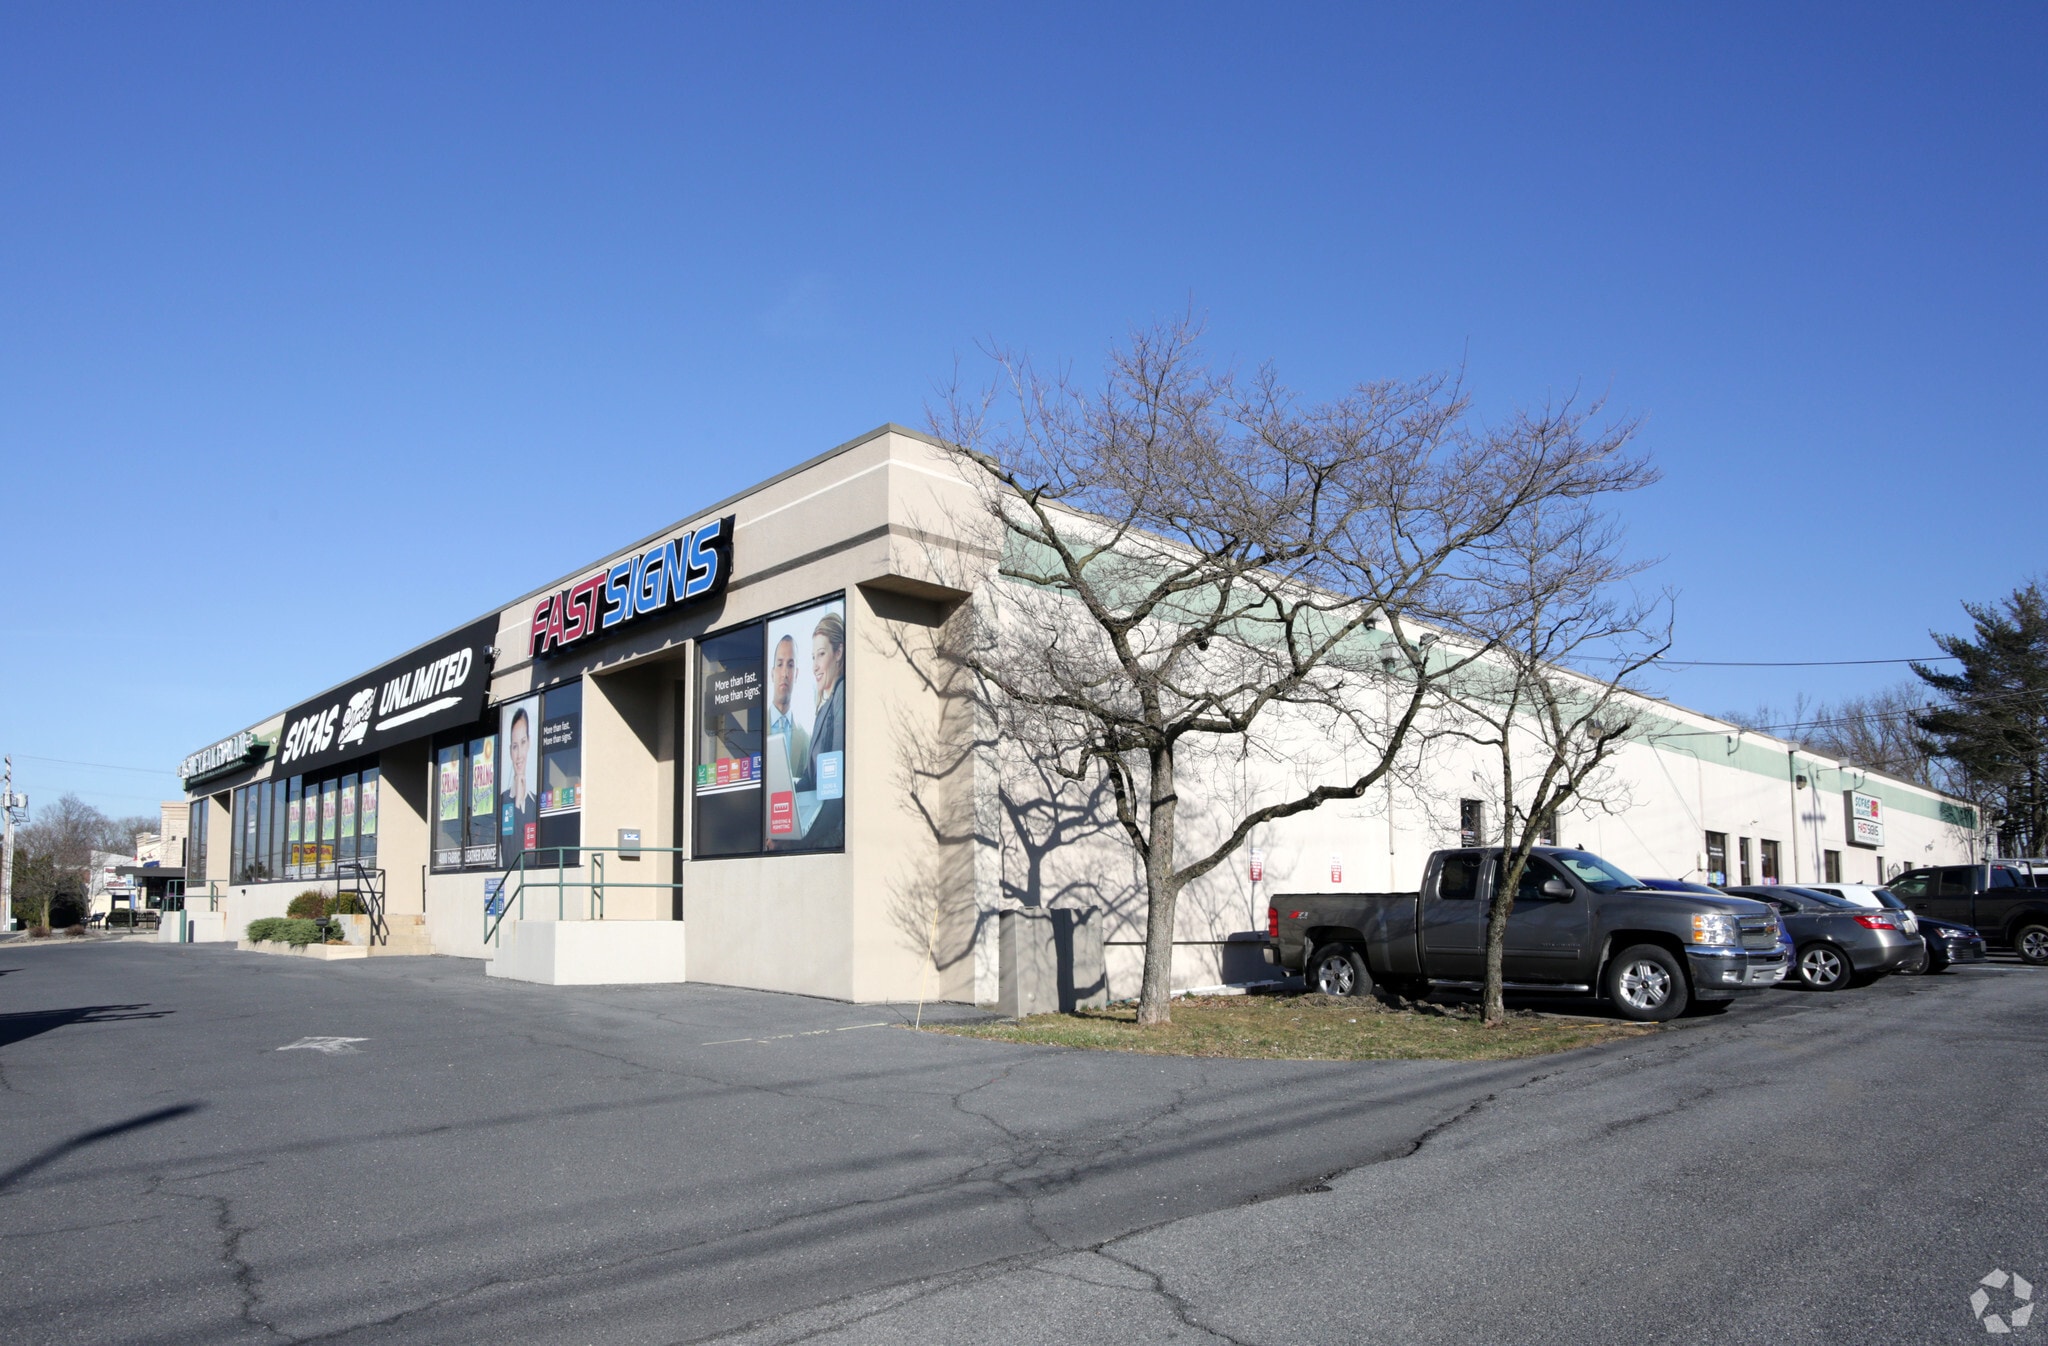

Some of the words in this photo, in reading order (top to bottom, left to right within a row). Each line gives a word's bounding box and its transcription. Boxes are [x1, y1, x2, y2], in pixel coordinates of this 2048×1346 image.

[528, 518, 721, 658] FASTSIGNS
[715, 680, 729, 691] More
[730, 675, 743, 688] than
[744, 672, 757, 684] fast.
[281, 704, 339, 764] SOFAS
[378, 647, 473, 716] UNLIMITED
[715, 693, 729, 705] More
[730, 689, 743, 701] than
[543, 726, 553, 735] More
[553, 723, 562, 733] than
[543, 737, 553, 746] More
[553, 734, 562, 744] than
